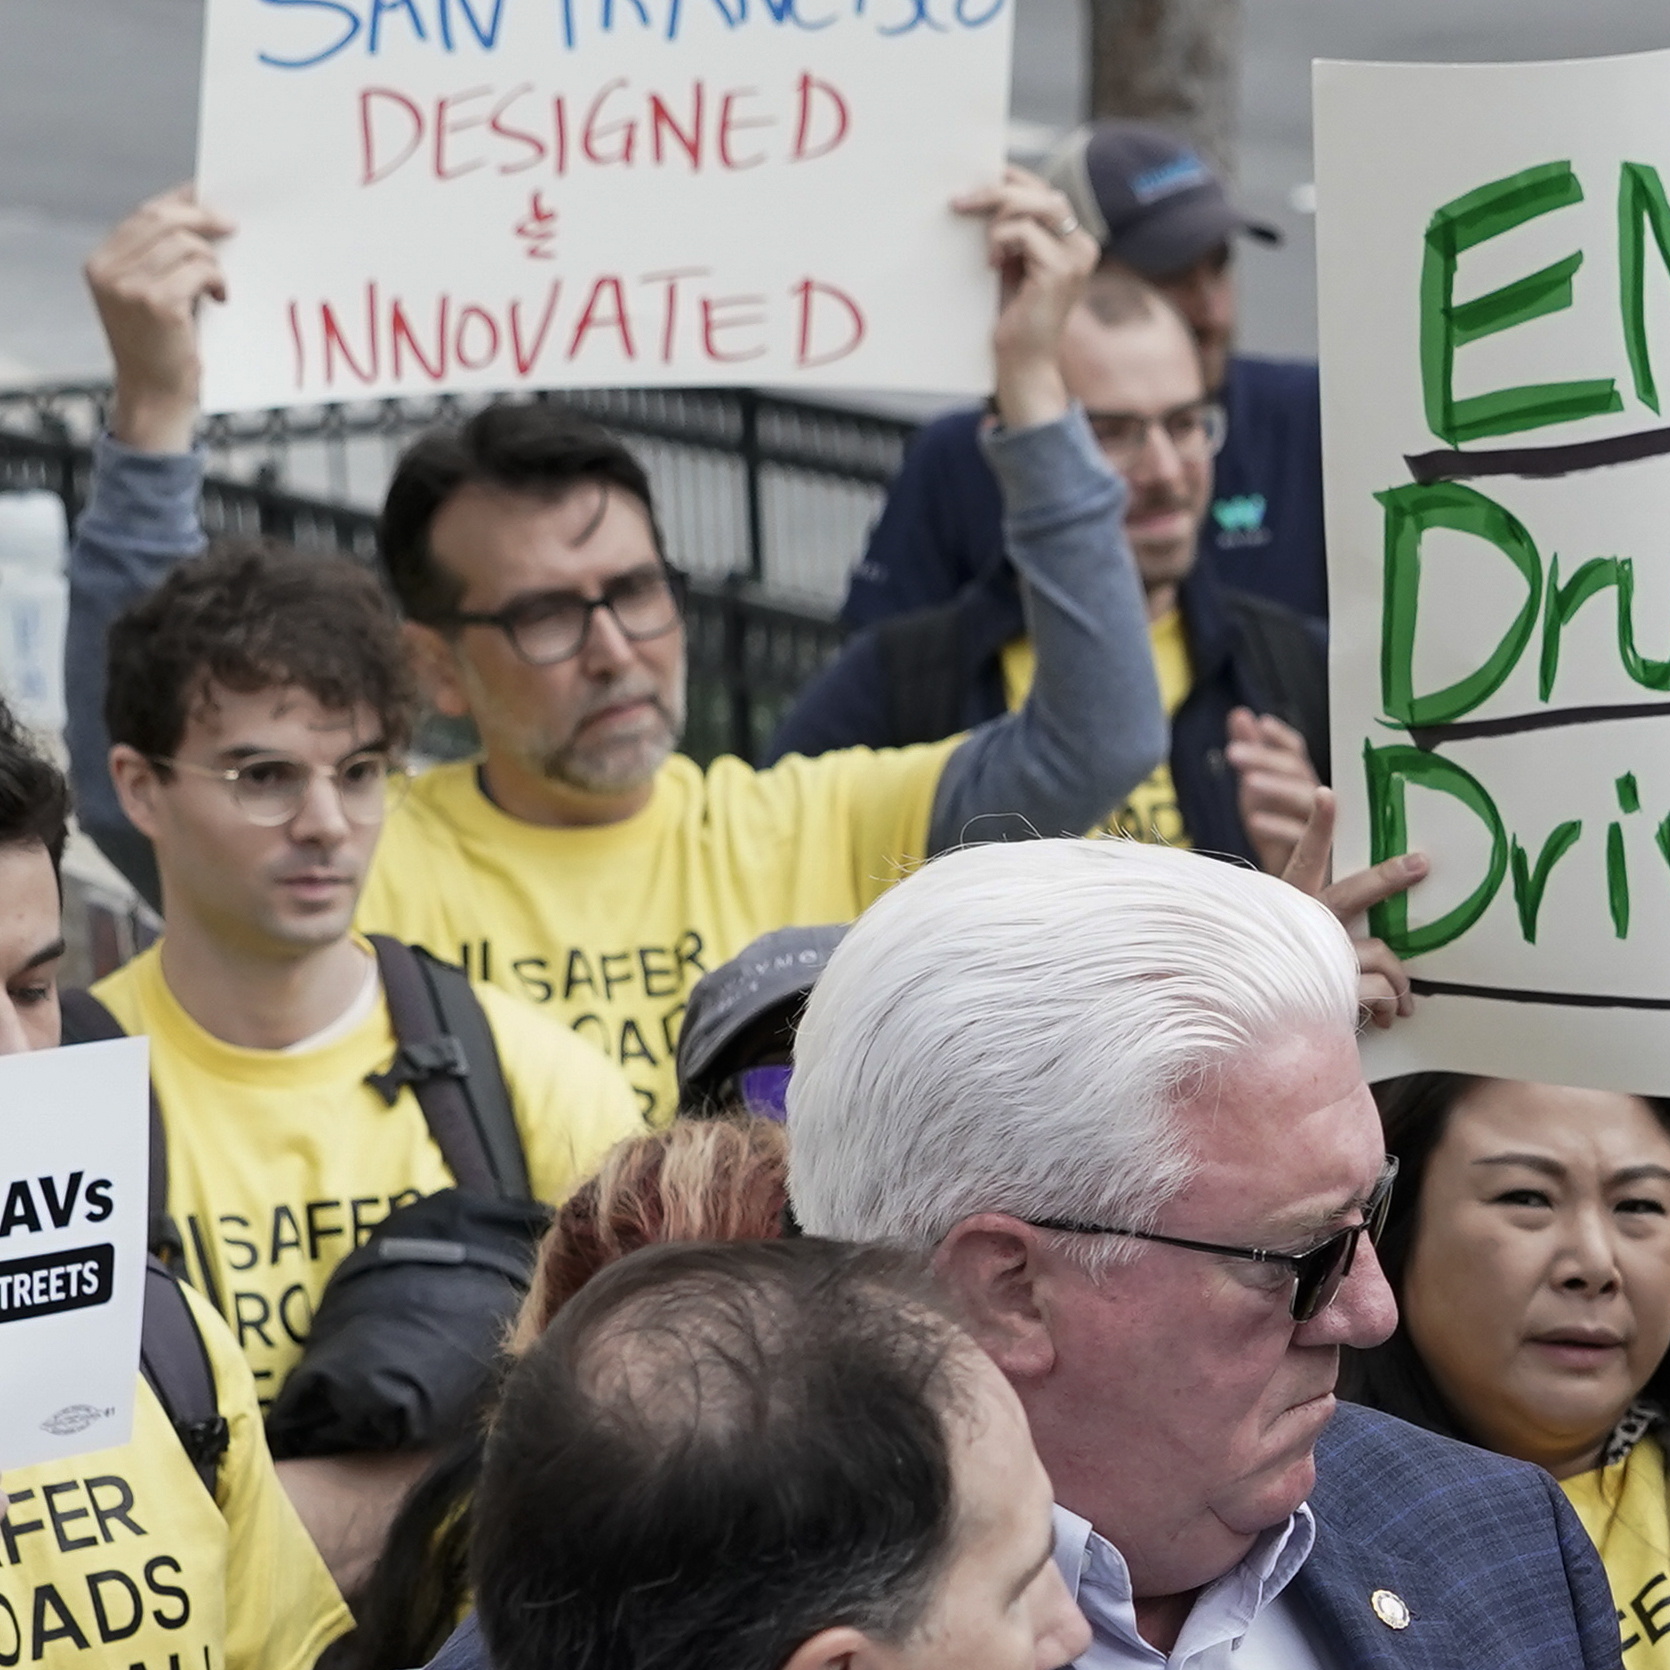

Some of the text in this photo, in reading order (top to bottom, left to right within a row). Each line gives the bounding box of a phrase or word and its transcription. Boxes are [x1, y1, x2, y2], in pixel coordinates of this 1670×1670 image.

[360, 72, 850, 185] DESIGNED
[289, 275, 866, 389] INNOVATED
[513, 930, 706, 1002] SAFER
[0, 1171, 114, 1237] AVs
[219, 1189, 423, 1271] SAFE
[0, 1475, 148, 1568] FER
